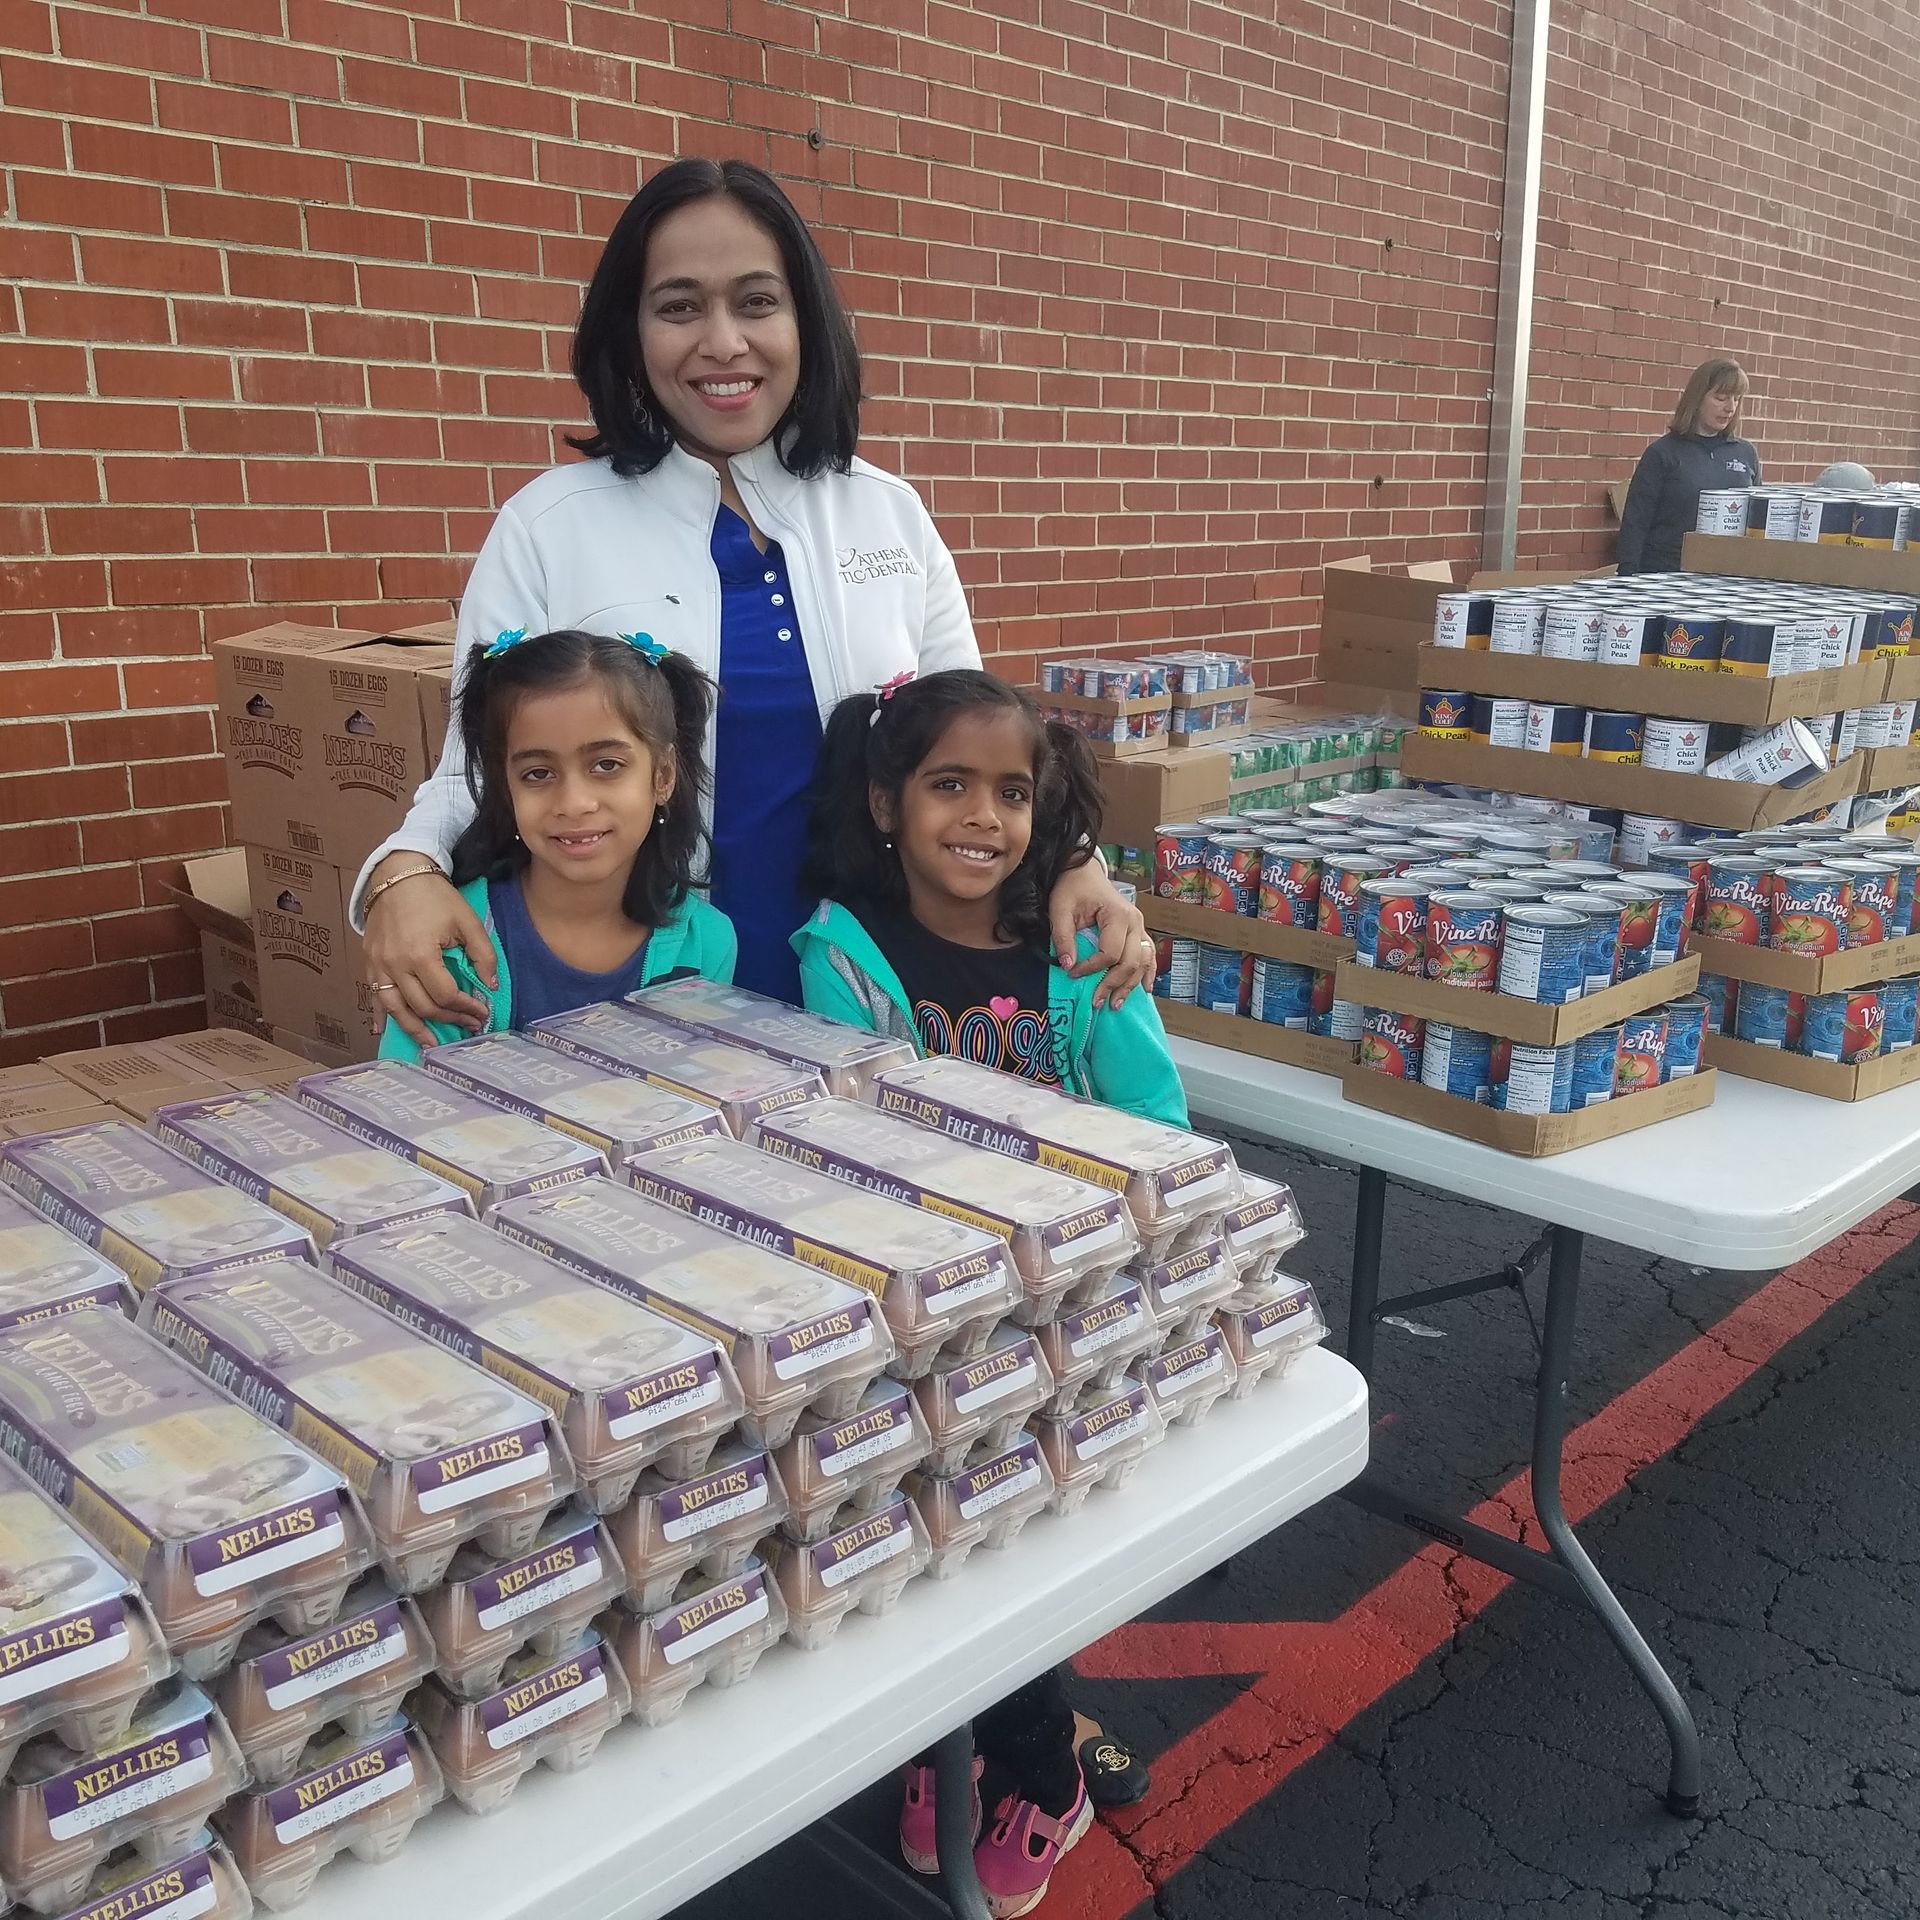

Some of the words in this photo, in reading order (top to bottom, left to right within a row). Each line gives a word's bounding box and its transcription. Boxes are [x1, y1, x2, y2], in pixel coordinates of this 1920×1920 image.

[856, 547, 909, 566] ATHENS
[865, 561, 918, 579] DENTAL
[1582, 637, 1600, 645] Chic
[1610, 642, 1632, 650] Chick
[1610, 651, 1628, 659] Peas
[1820, 643, 1840, 651] Chick
[1877, 648, 1900, 658] Chick
[233, 655, 241, 670] 15
[242, 657, 264, 675] DOZEN
[266, 660, 285, 677] EGGS
[329, 669, 339, 685] 15
[340, 672, 364, 687] DOZEN
[367, 675, 388, 692] EGGS
[227, 716, 304, 760] NELLIE'S
[1446, 732, 1468, 740] Peas
[323, 734, 407, 780] NELLIE'S
[1676, 750, 1698, 758] Chick
[1755, 757, 1769, 775] Peas
[1763, 751, 1779, 772] Chick
[271, 855, 293, 874] DOZEN
[295, 858, 313, 878] EGGS
[1163, 848, 1200, 871] Vine
[1211, 854, 1249, 884] Ripe
[1270, 864, 1305, 894] Ripe
[1323, 874, 1356, 907] Ripe
[1732, 881, 1773, 909] Ripe
[1775, 891, 1812, 915] Vine
[1813, 892, 1850, 919] Ripe
[1860, 882, 1894, 910] Ripe
[257, 908, 332, 957] NELLIE'S
[1393, 911, 1427, 936] Vin
[1433, 920, 1477, 946] Vine
[1377, 1013, 1417, 1044] Ripe
[1861, 1007, 1886, 1030] Vin
[758, 1087, 807, 1114] NELLIE'S
[653, 1124, 706, 1148] NELLIE'S
[882, 1089, 943, 1127] NELLIE'S
[945, 1114, 979, 1139] FREE
[982, 1127, 1030, 1158] RANGE
[762, 1133, 823, 1170] NELLIE'S
[528, 1166, 586, 1193] NELLIE'S
[1100, 1170, 1125, 1195] HENS
[1172, 1157, 1216, 1187] NELLIE'S
[633, 1175, 694, 1214] NELLIE'S
[698, 1205, 733, 1231] FREE
[736, 1221, 784, 1250] RANGE
[1058, 1209, 1108, 1241] NELLIE'S
[1237, 1199, 1278, 1226] NELLIE'S
[936, 1256, 990, 1290] NELLIE'S
[1166, 1250, 1211, 1282] NELLIE'S
[336, 1265, 391, 1310] NELLIE'S
[1080, 1300, 1128, 1335] NELLIE'S
[1260, 1297, 1301, 1328] NELLIE'S
[787, 1312, 853, 1353] NELLIE'S
[153, 1305, 210, 1364] NELLIE'S
[208, 1351, 240, 1392] FREE
[240, 1382, 286, 1428] RANGE
[965, 1352, 1019, 1389] NELLIE'S
[1163, 1343, 1209, 1377] NELLIE'S
[625, 1365, 699, 1411] NELLIE'S
[832, 1409, 894, 1451] NELLIE'S
[1083, 1400, 1133, 1437] NELLIE'S
[438, 1435, 524, 1483] NELLIE'S
[969, 1455, 1023, 1495] NELLIE'S
[678, 1470, 749, 1515] NELLIE'S
[216, 1506, 316, 1563] NELLIE'S
[832, 1515, 894, 1560] NELLIE'S
[496, 1546, 577, 1600] NELLIE'S
[676, 1585, 748, 1635] NELLIE'S
[0, 1616, 96, 1674] ELLIE'S
[286, 1618, 379, 1677] NELLIE'S
[503, 1662, 584, 1718] NELLIE'S
[73, 1740, 181, 1805] NELLIE'S
[295, 1750, 386, 1810] NELLIE'S
